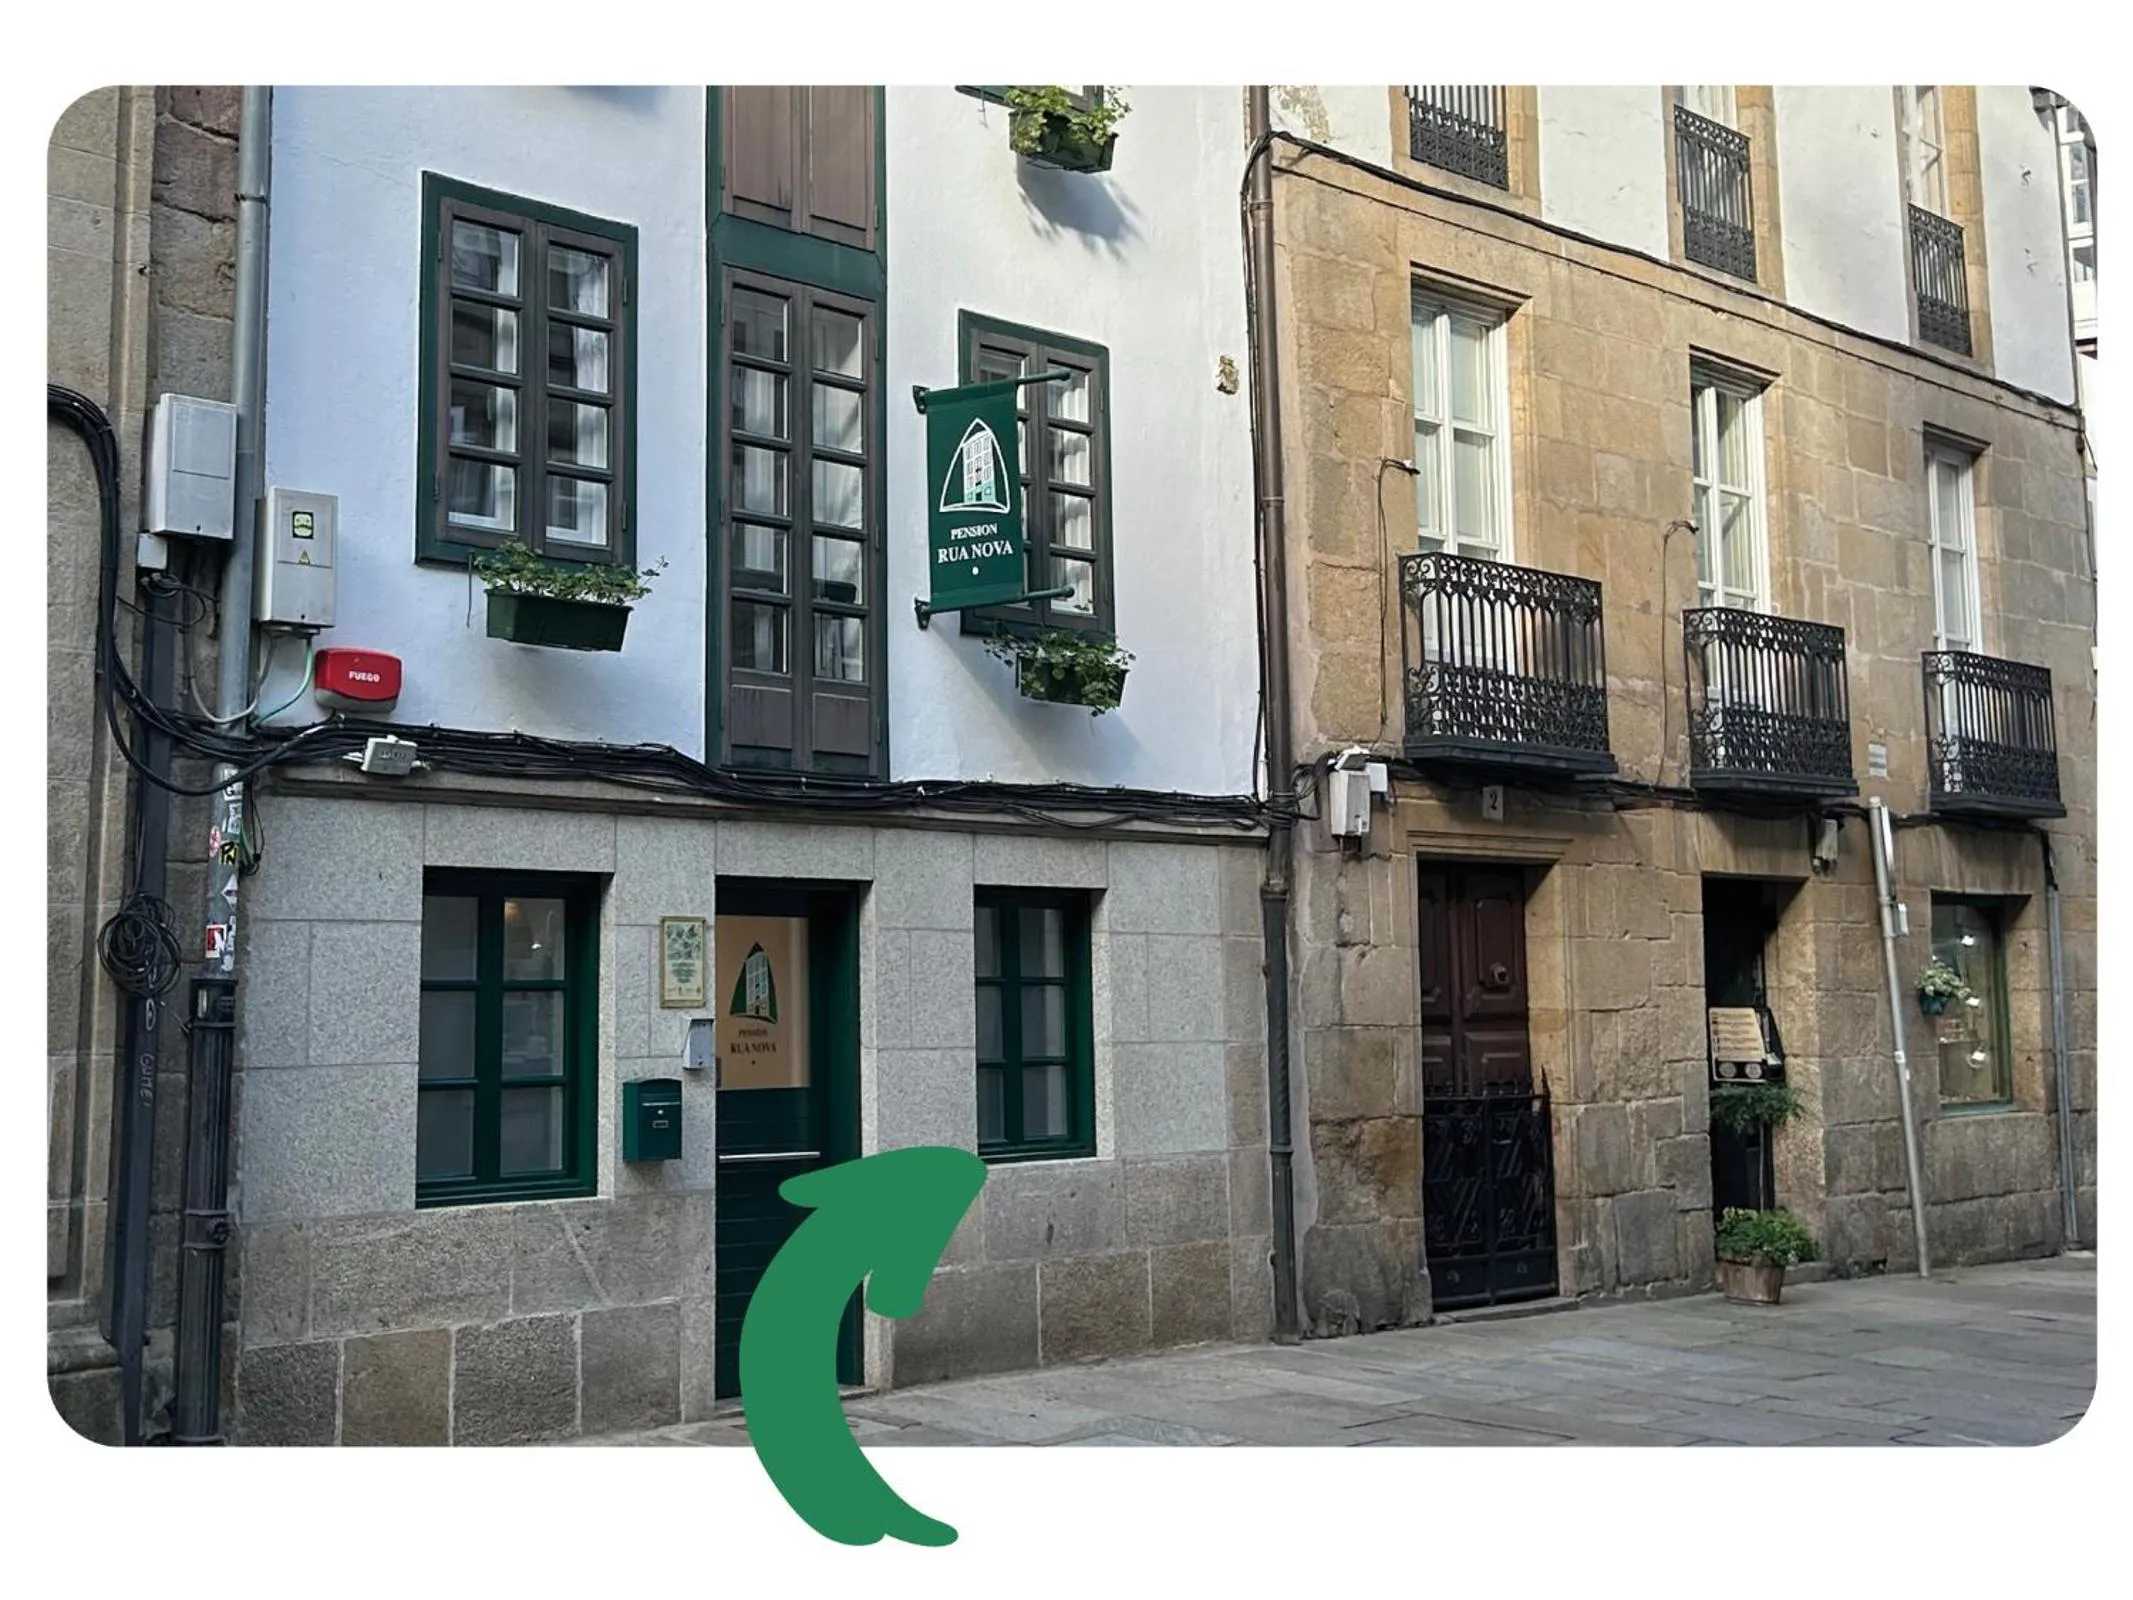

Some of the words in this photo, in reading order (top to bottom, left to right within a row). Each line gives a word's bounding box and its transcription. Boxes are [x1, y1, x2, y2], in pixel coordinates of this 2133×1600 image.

[950, 523, 998, 540] PENSION
[937, 546, 969, 563] RUA
[971, 540, 1013, 559] NOVA
[348, 670, 380, 682] FUEGO
